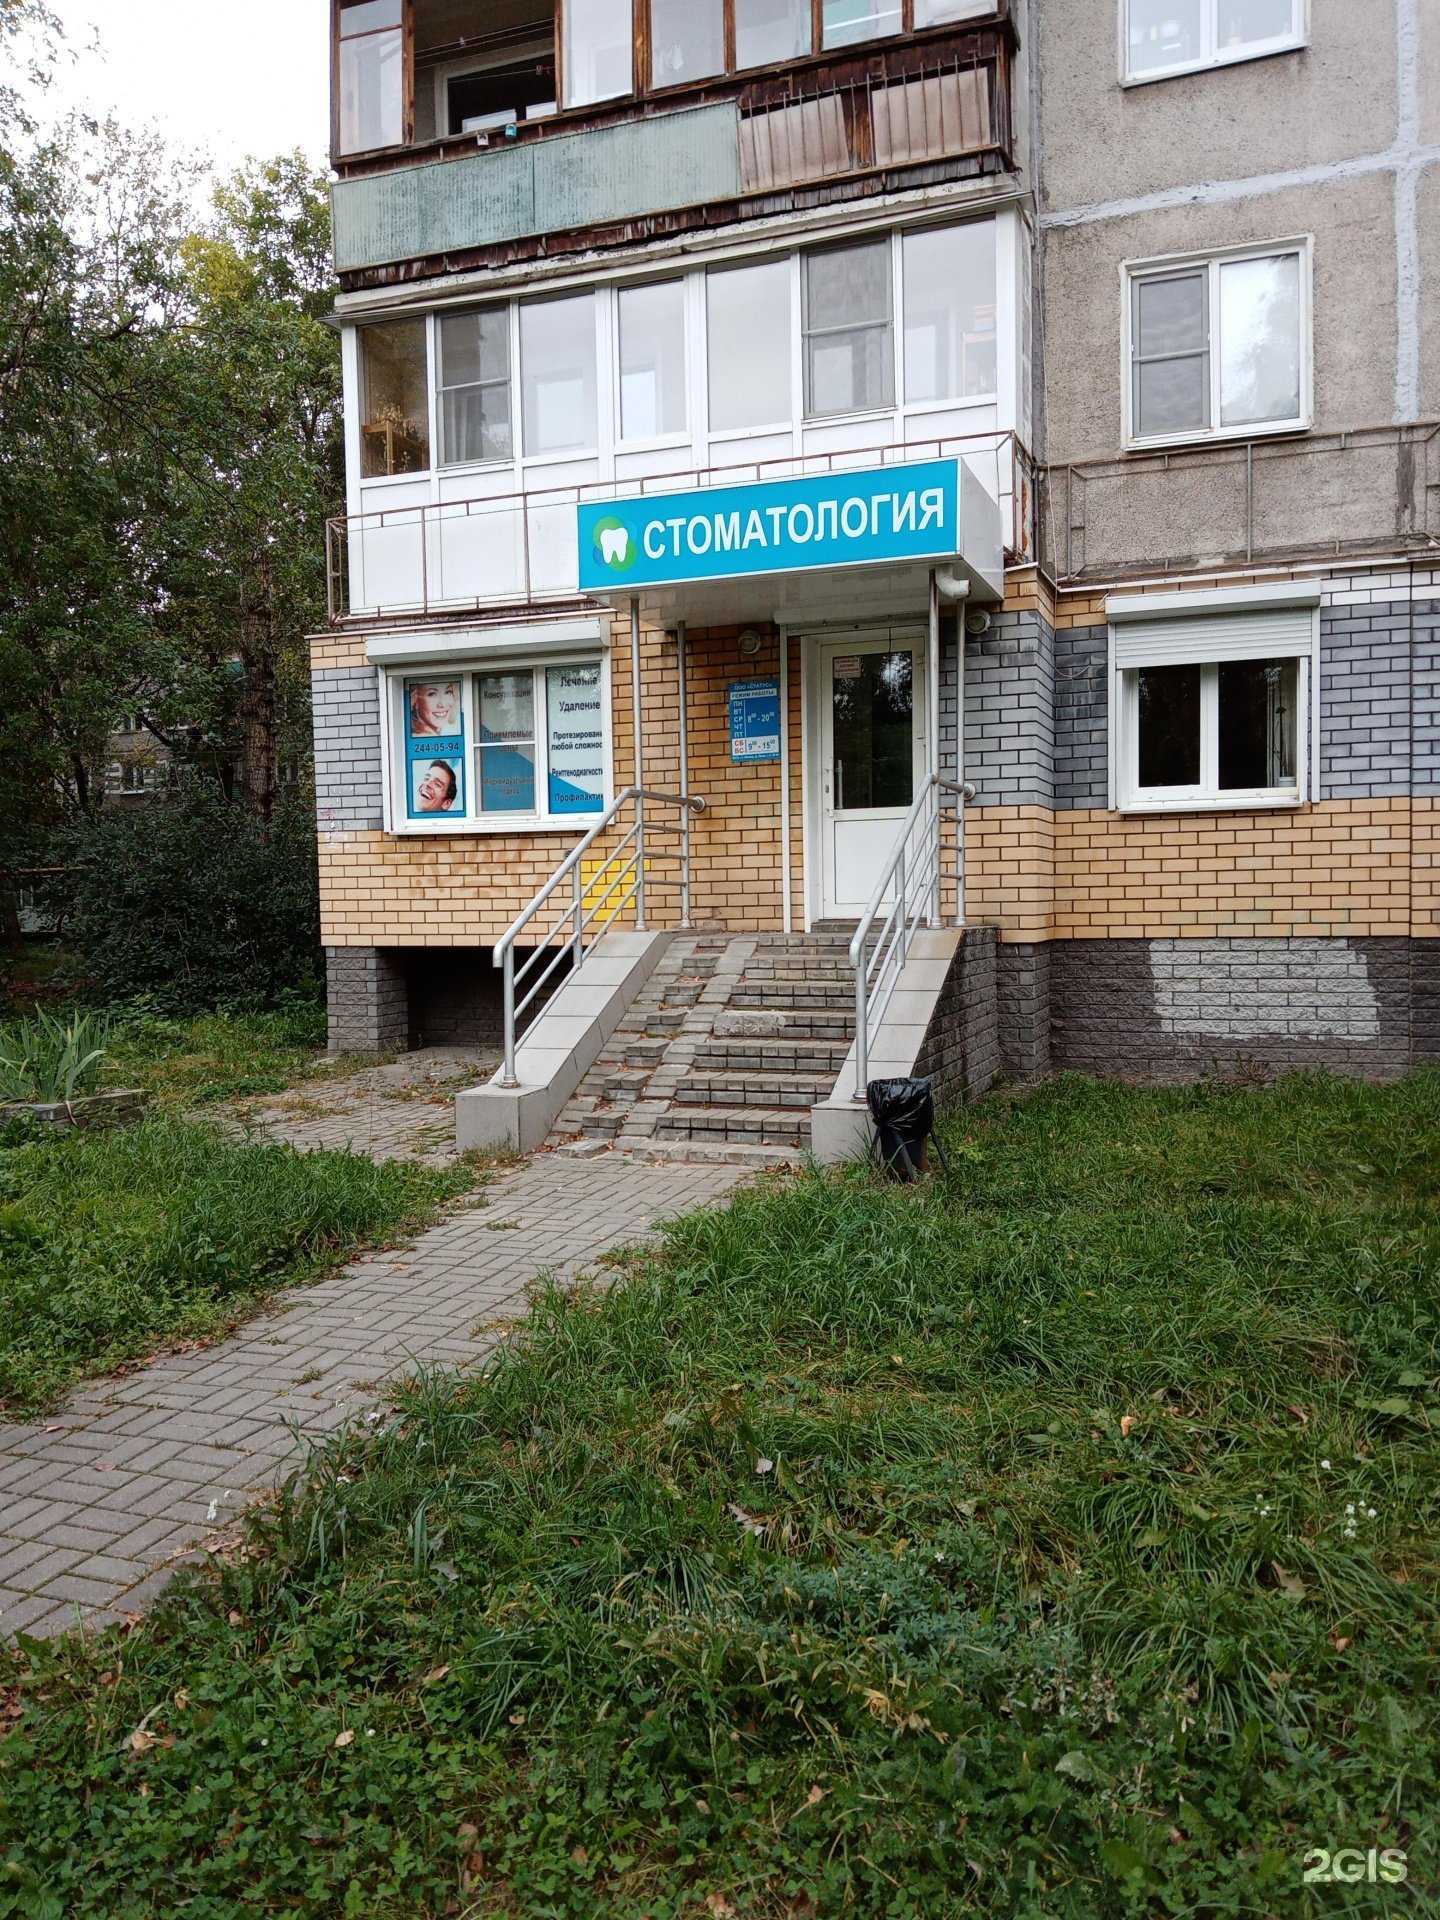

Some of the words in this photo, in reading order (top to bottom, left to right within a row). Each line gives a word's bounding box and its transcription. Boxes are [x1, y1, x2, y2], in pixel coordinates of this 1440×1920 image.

[643, 488, 944, 560] СТОМАТОЛОГИЯ
[560, 676, 598, 688] Лечение
[559, 700, 601, 712] Удаление
[414, 742, 459, 753] 244-05-94
[551, 742, 574, 751] любой
